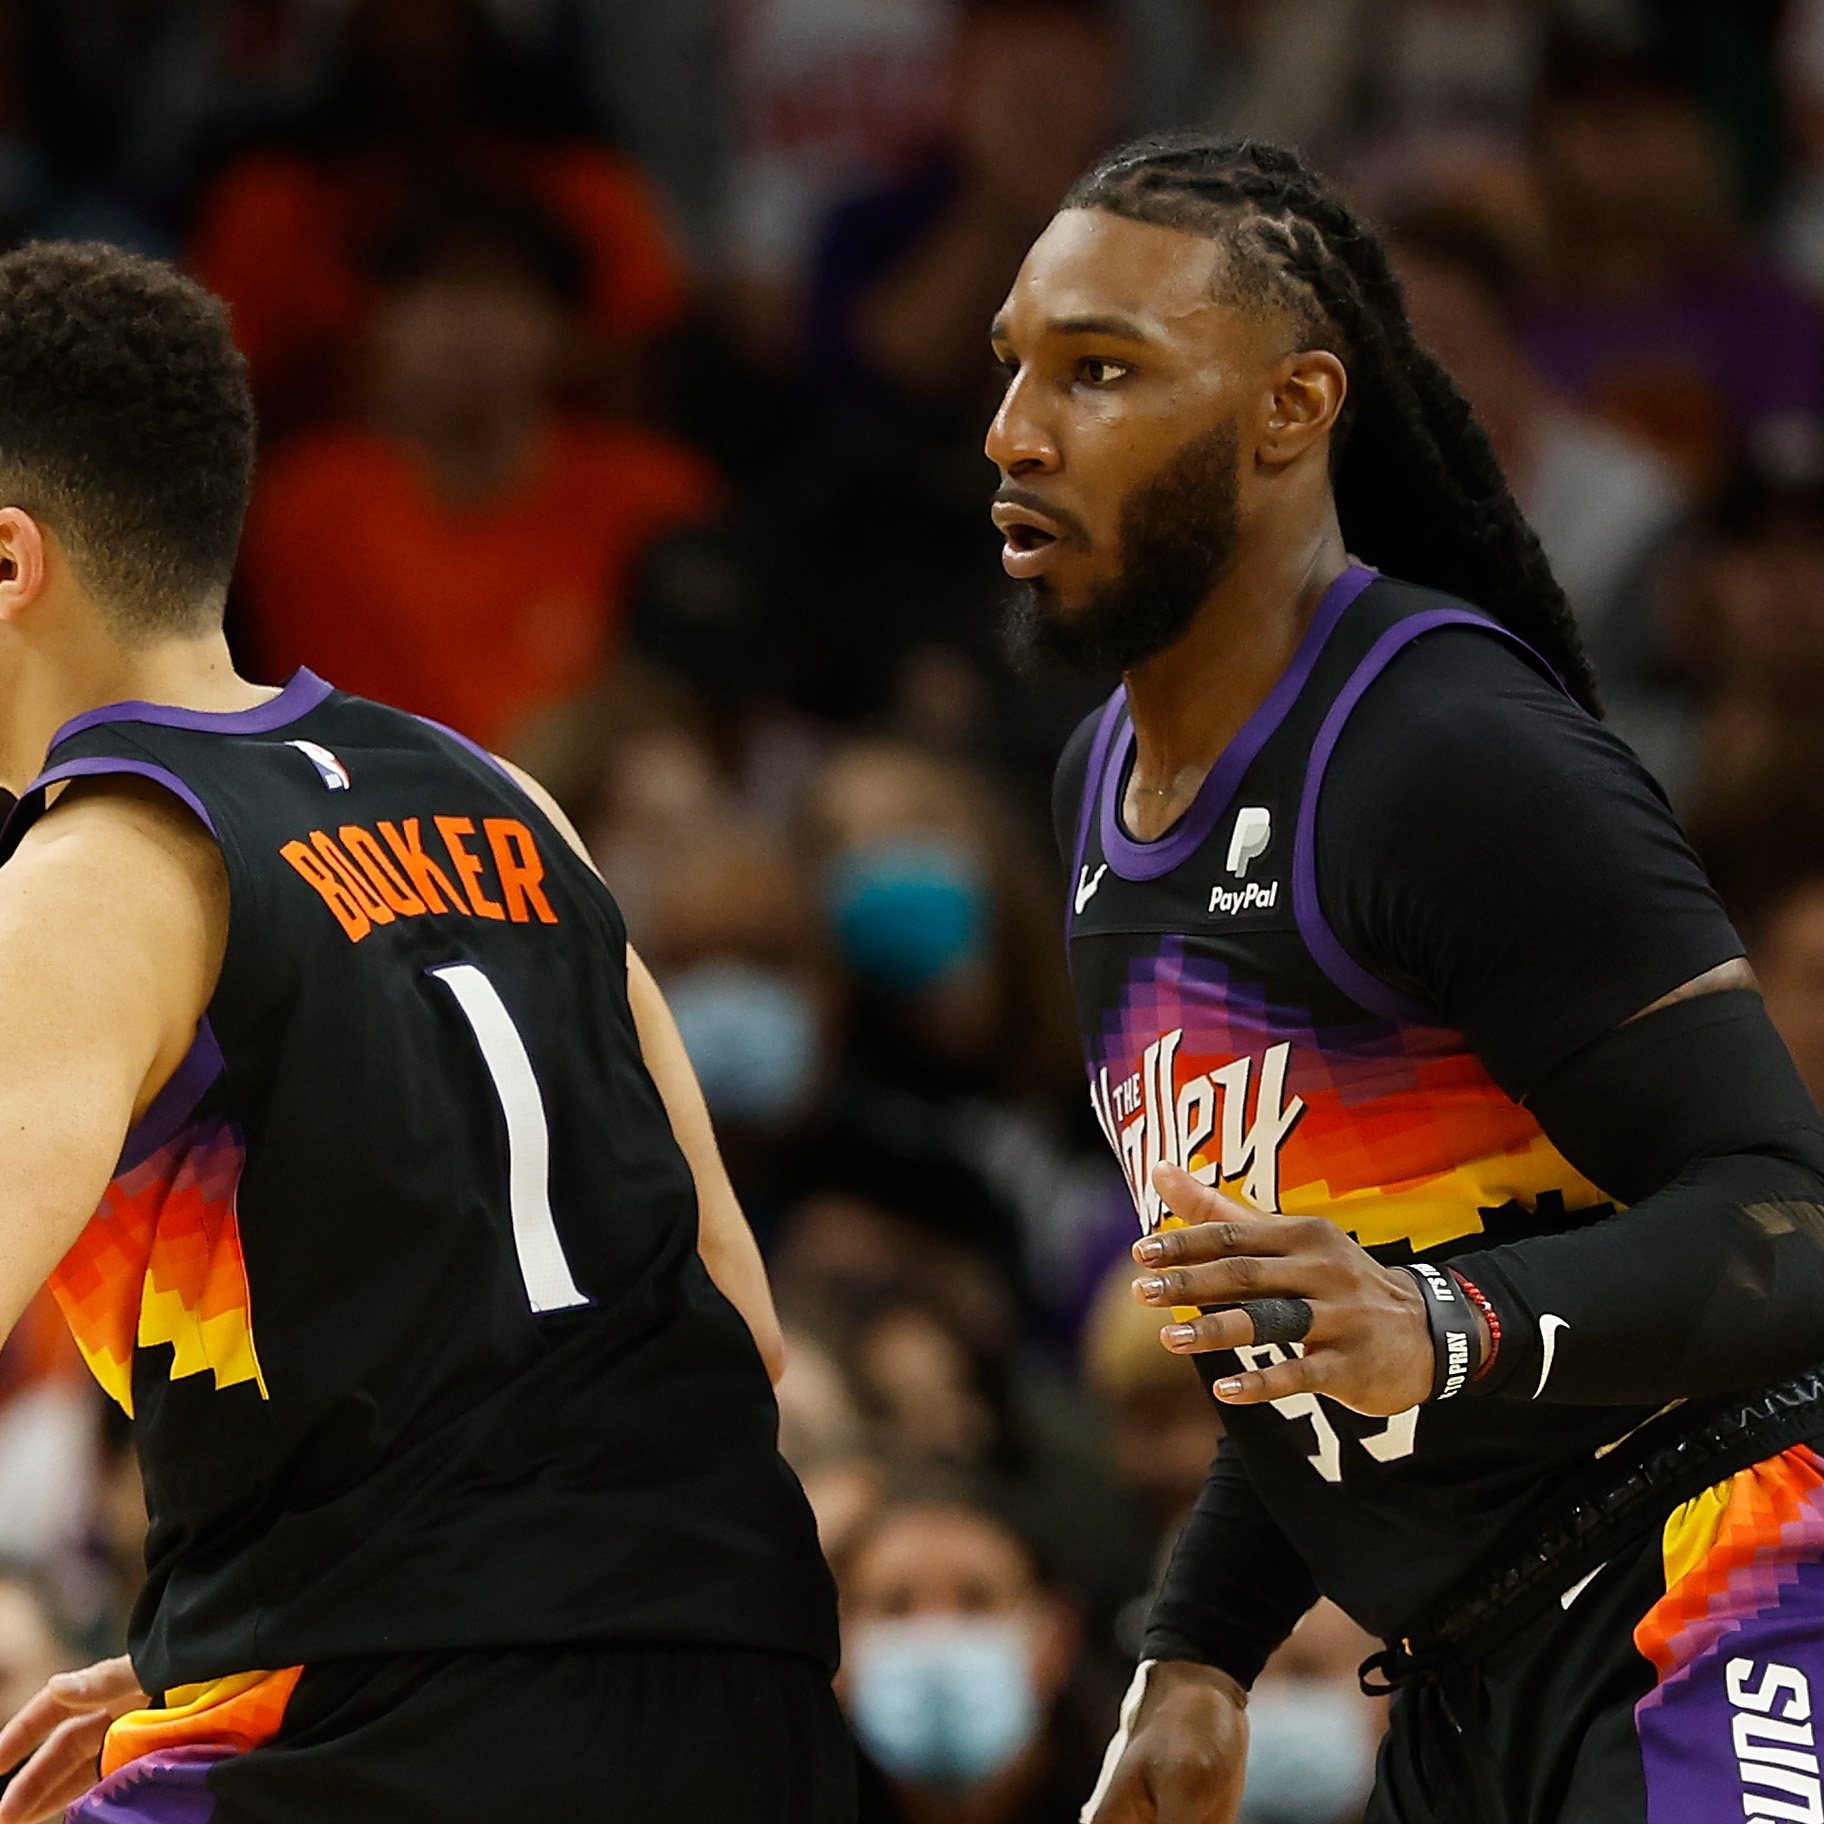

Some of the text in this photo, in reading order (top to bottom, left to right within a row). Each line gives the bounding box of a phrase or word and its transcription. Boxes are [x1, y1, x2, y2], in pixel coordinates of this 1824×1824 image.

[279, 813, 559, 944] BOOKER
[1207, 880, 1280, 915] PayPal
[1112, 1072, 1142, 1122] THE
[427, 961, 598, 1315] 1
[1445, 1331, 1469, 1375] PRAY
